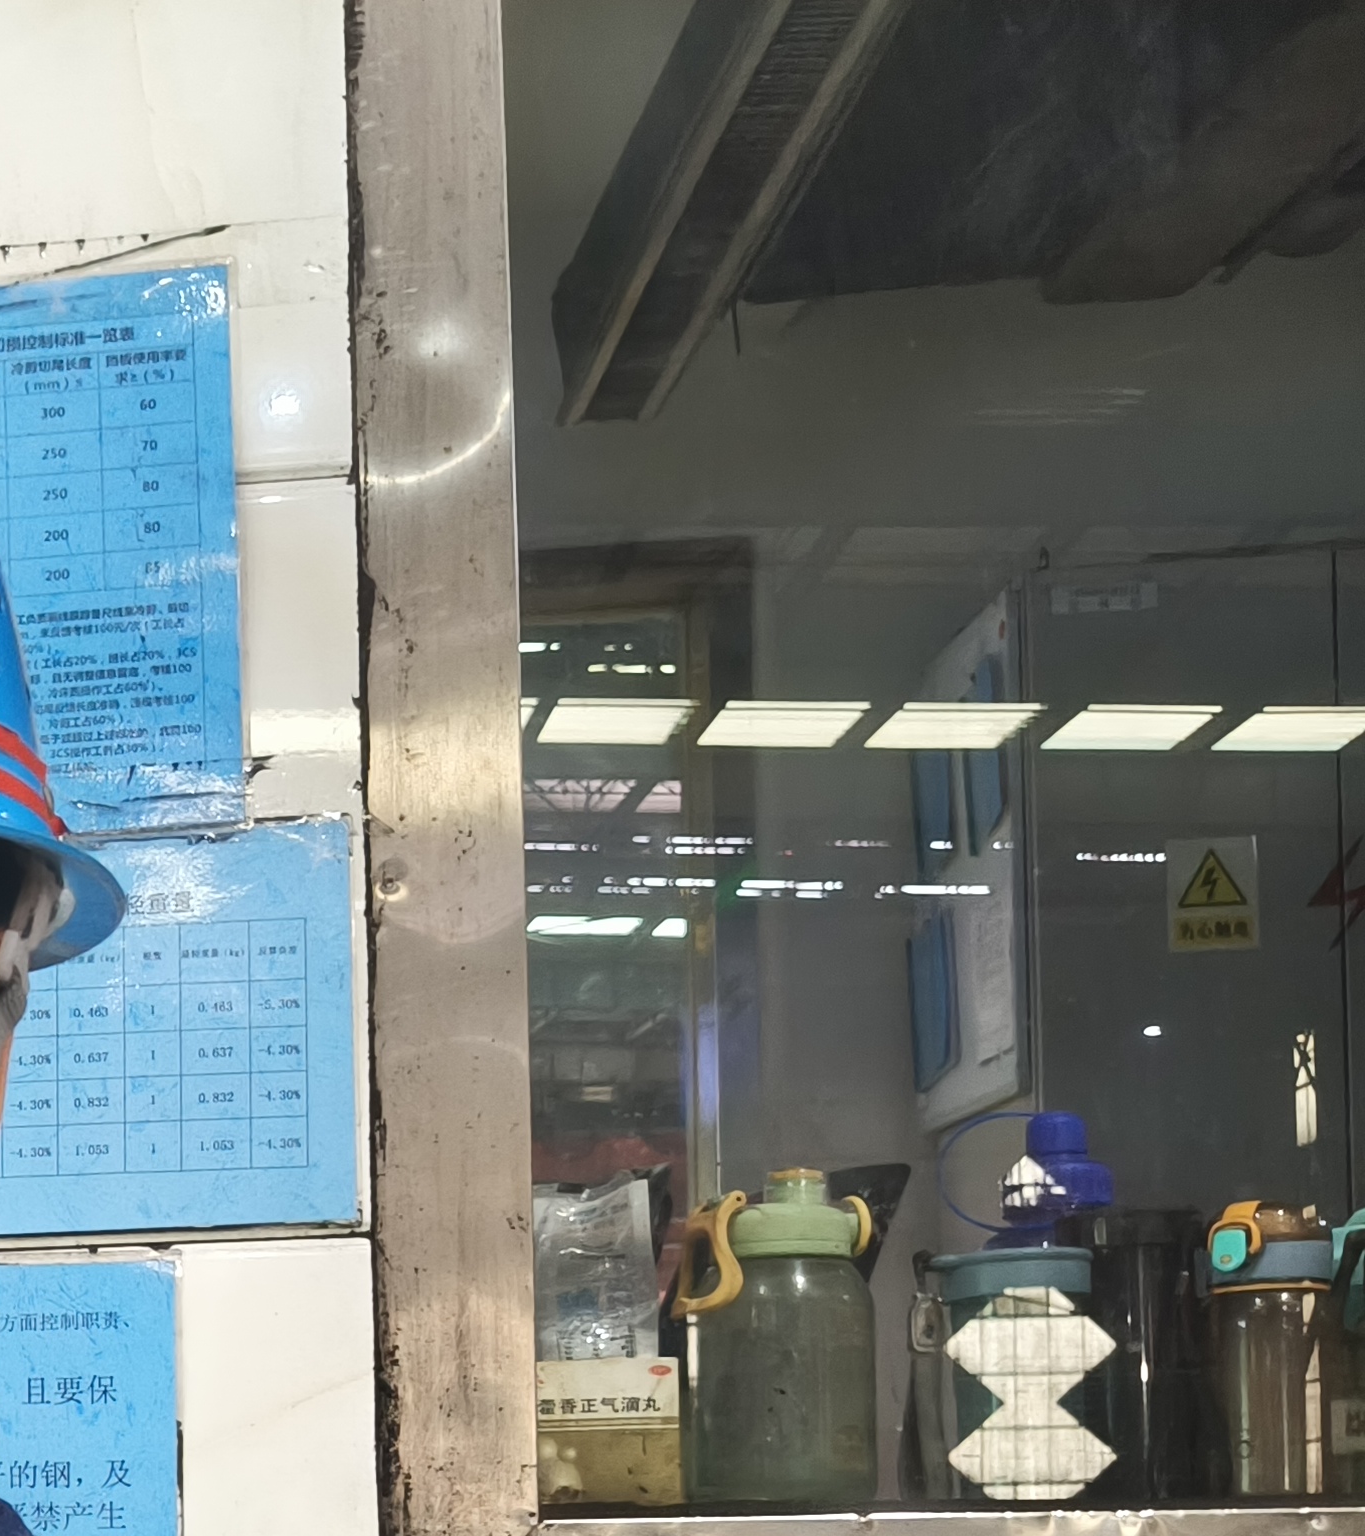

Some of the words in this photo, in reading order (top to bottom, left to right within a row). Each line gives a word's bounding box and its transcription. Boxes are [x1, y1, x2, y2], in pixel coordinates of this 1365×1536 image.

[139, 398, 157, 411] 60
[40, 406, 66, 420] 300
[141, 439, 158, 452] 70
[41, 447, 67, 461] 250
[141, 479, 159, 493] 80
[42, 487, 68, 501] 250
[143, 520, 161, 534] 80
[43, 528, 69, 542] 200
[44, 568, 70, 582] 200
[73, 1052, 109, 1064] 0.637
[198, 1046, 234, 1059] 0.637
[73, 1096, 110, 1108] 0.832
[198, 1091, 235, 1103] 0.832
[74, 1144, 110, 1156] 1.053
[200, 1140, 235, 1152] 1.053
